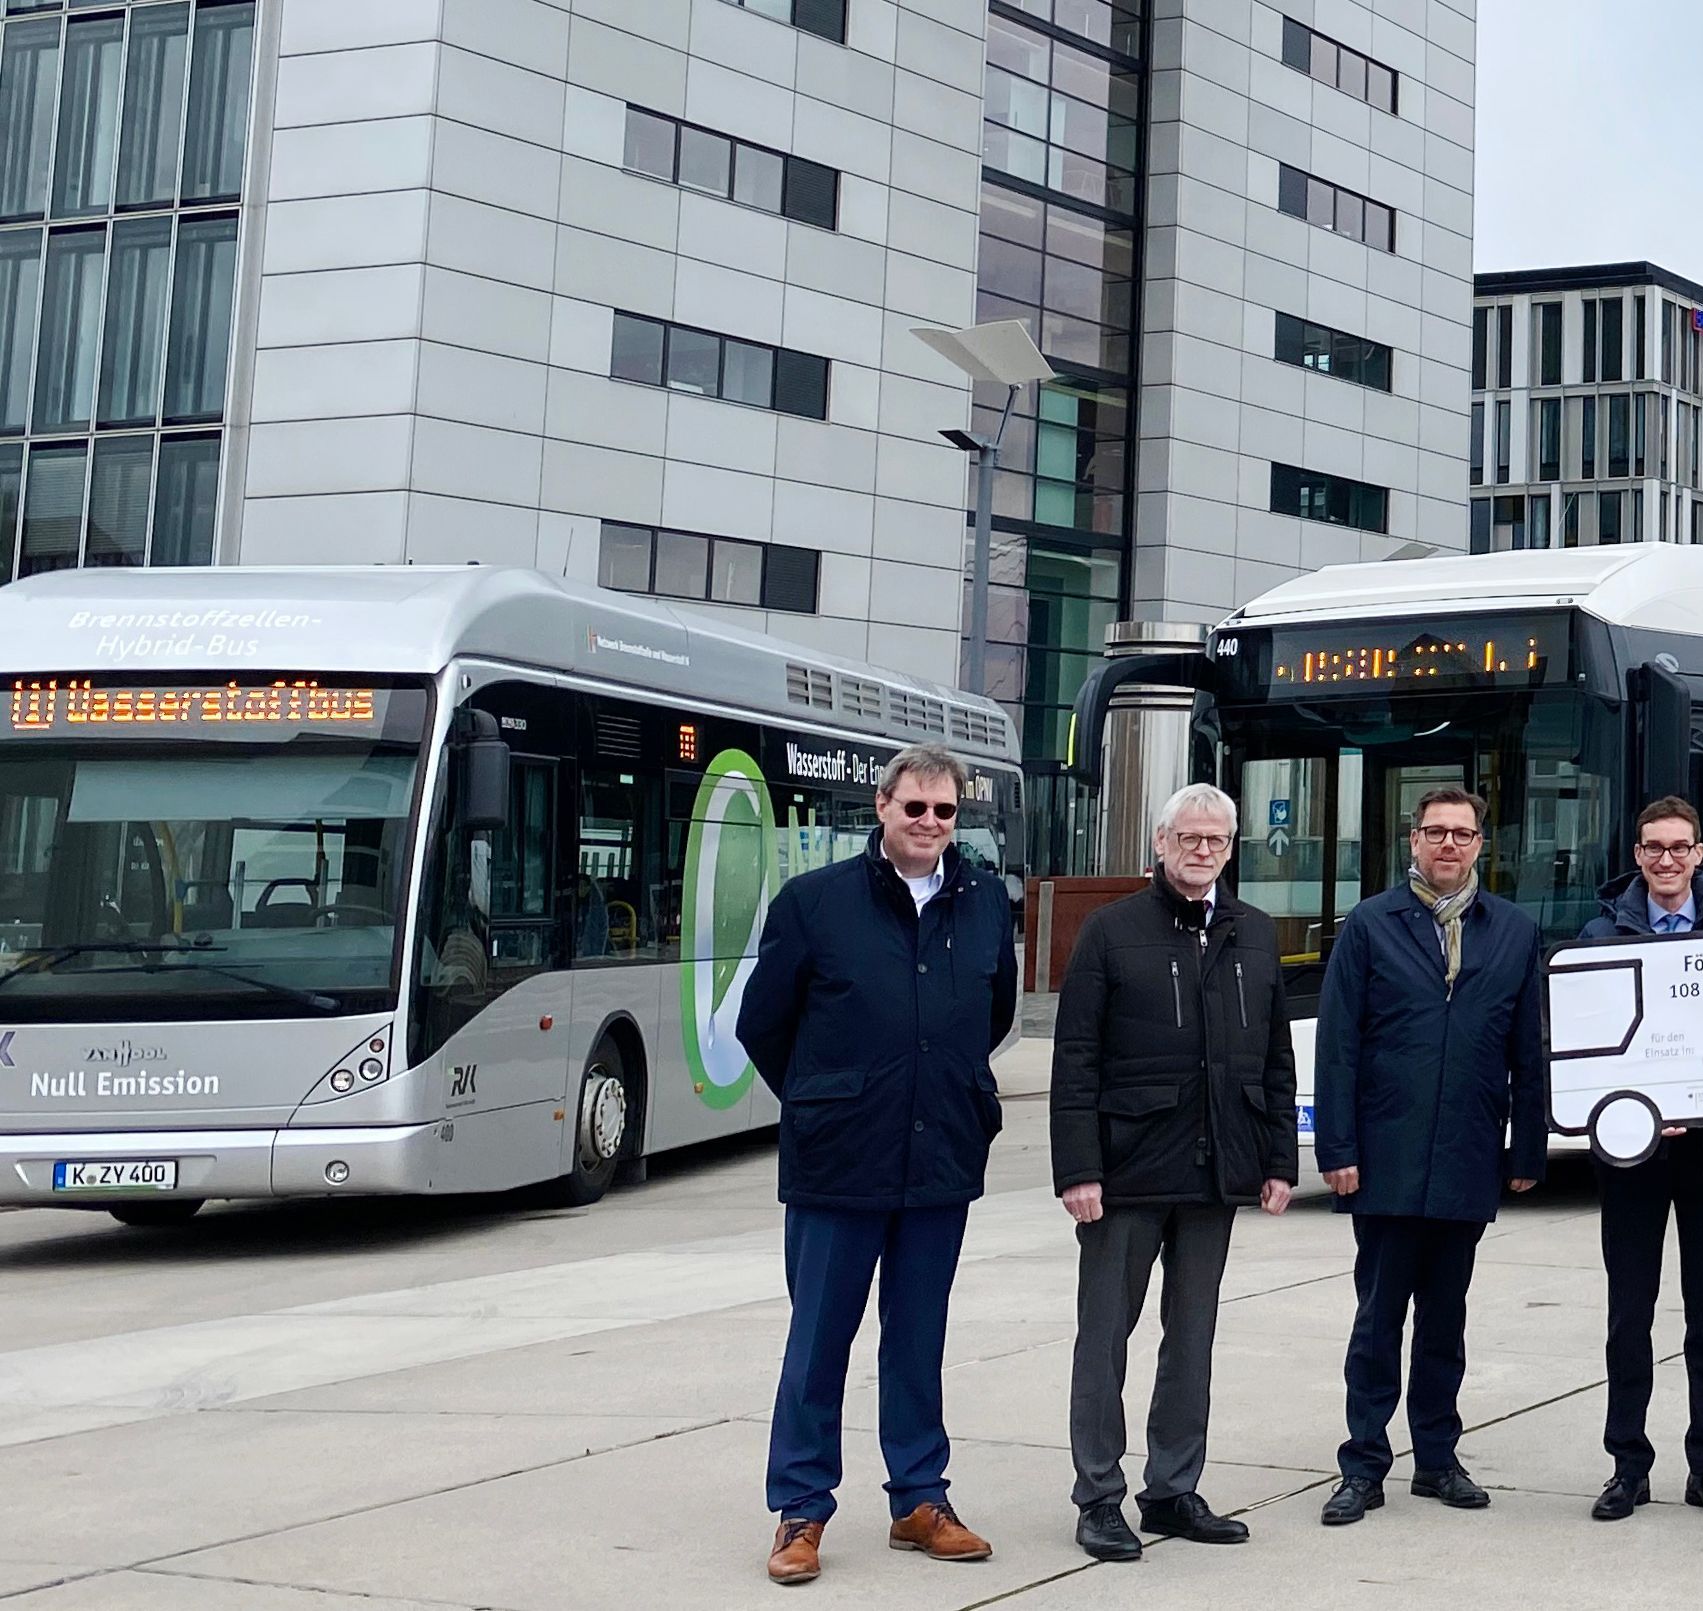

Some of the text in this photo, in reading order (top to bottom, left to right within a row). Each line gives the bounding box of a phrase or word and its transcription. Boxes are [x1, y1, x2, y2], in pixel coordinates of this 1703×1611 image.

[68, 609, 322, 629] Brennstoffzellen-
[96, 634, 259, 662] Hybrid-Bus
[1217, 637, 1239, 656] 440
[786, 742, 846, 782] Wasserstoff
[852, 753, 868, 785] Der
[1669, 982, 1700, 998] 108
[1651, 1032, 1685, 1044] für den
[1645, 1047, 1680, 1058] Einsatz
[30, 1069, 219, 1097] Null Emission
[73, 1165, 165, 1185] K ZY 400
